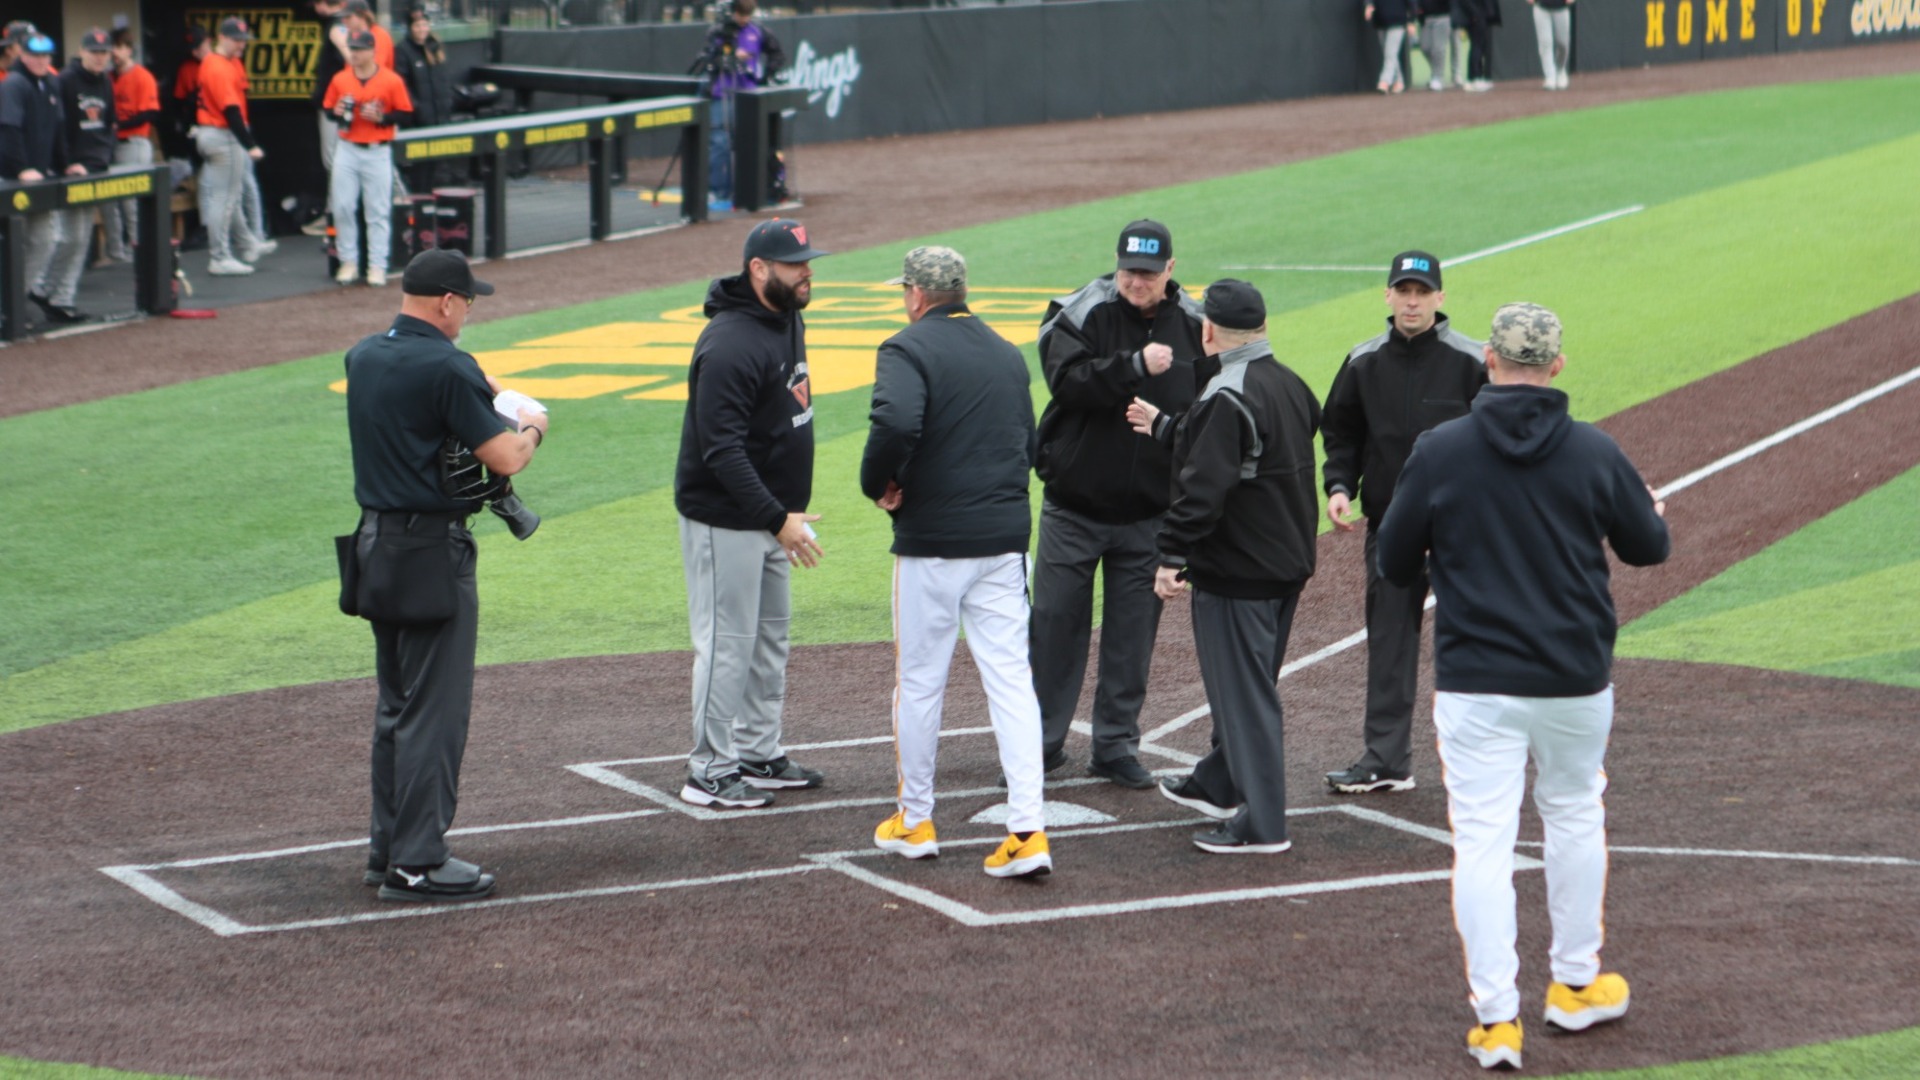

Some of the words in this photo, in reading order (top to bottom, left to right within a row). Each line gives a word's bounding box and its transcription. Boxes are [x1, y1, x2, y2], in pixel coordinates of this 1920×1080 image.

[1645, 0, 1754, 47] HOME
[1787, 0, 1826, 36] OF
[775, 41, 861, 117] lings
